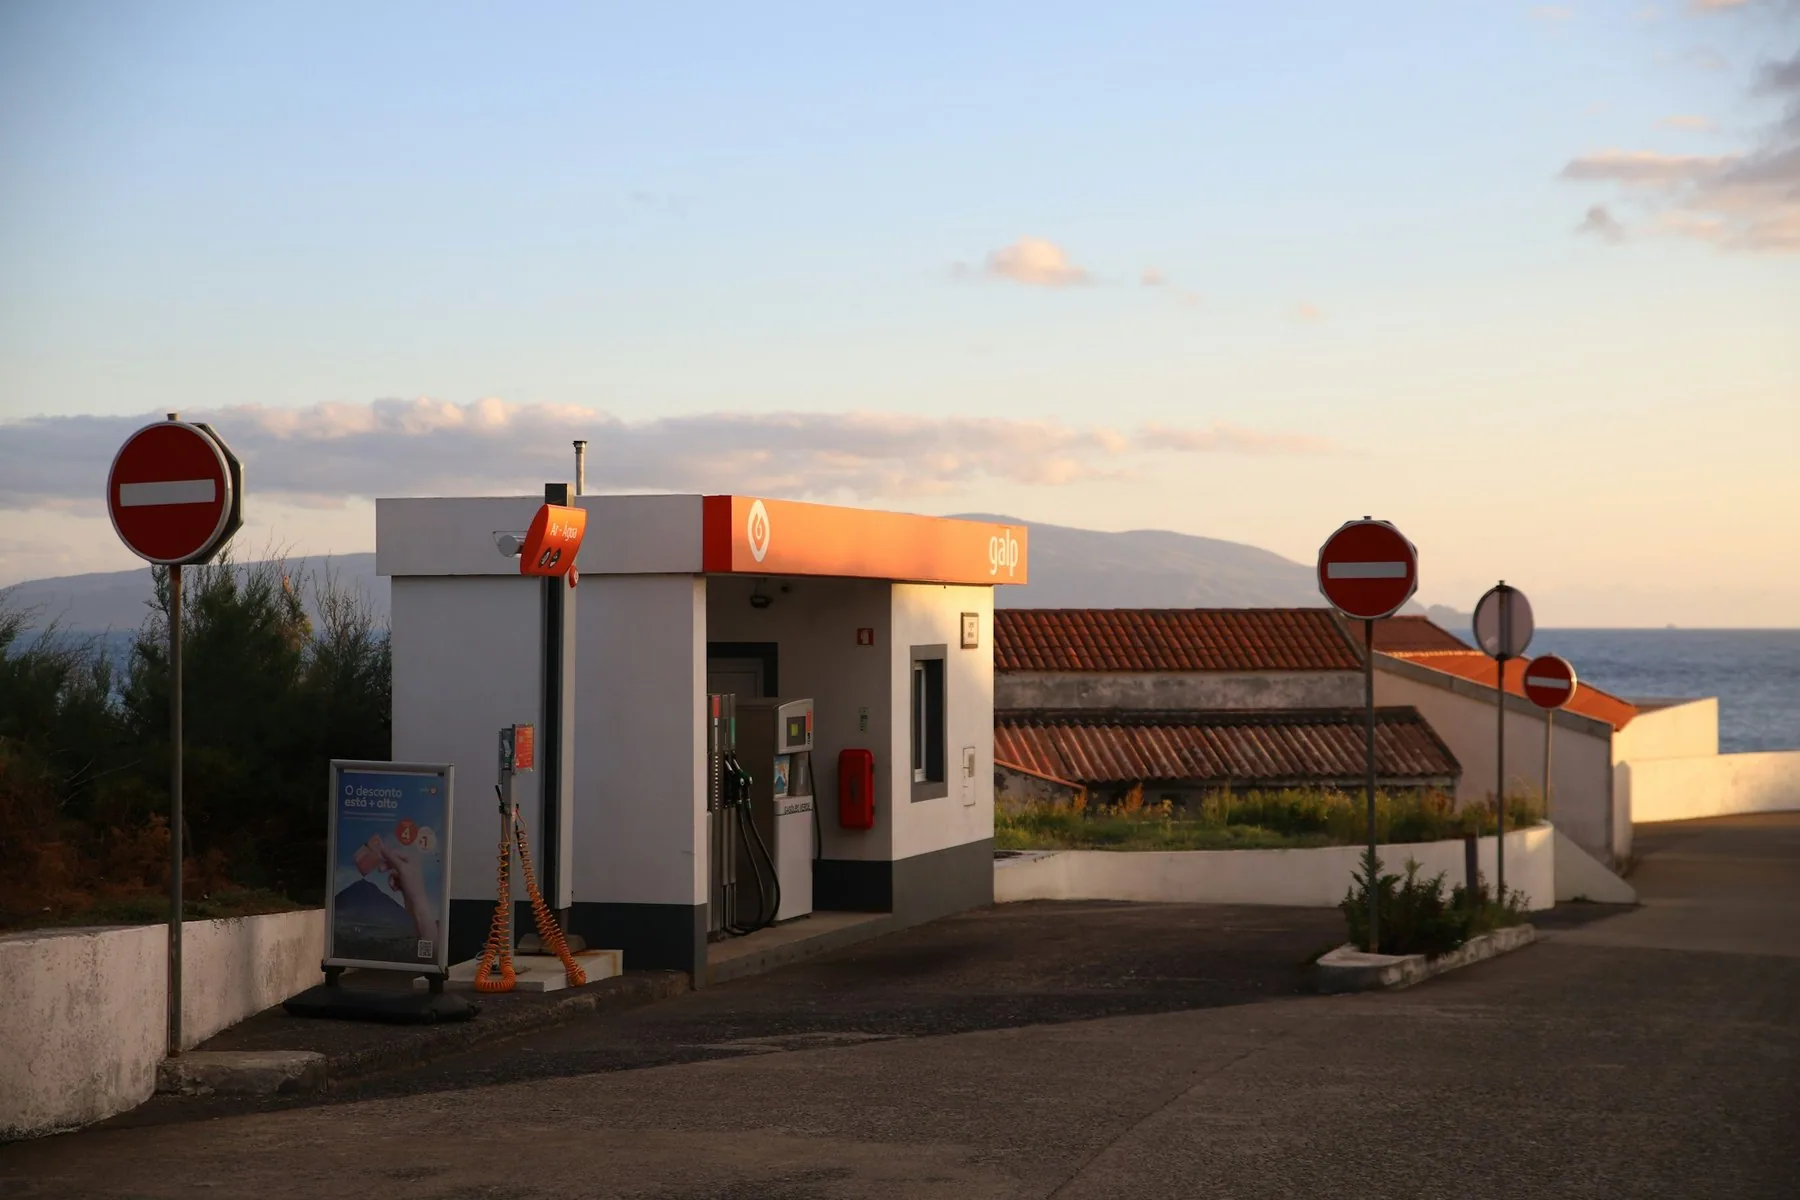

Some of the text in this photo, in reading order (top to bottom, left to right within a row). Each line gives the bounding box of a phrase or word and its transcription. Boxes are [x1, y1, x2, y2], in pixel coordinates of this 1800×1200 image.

[989, 529, 1019, 577] galp
[345, 784, 402, 799] O desconto
[344, 797, 367, 808] está
[377, 797, 398, 809] alto
